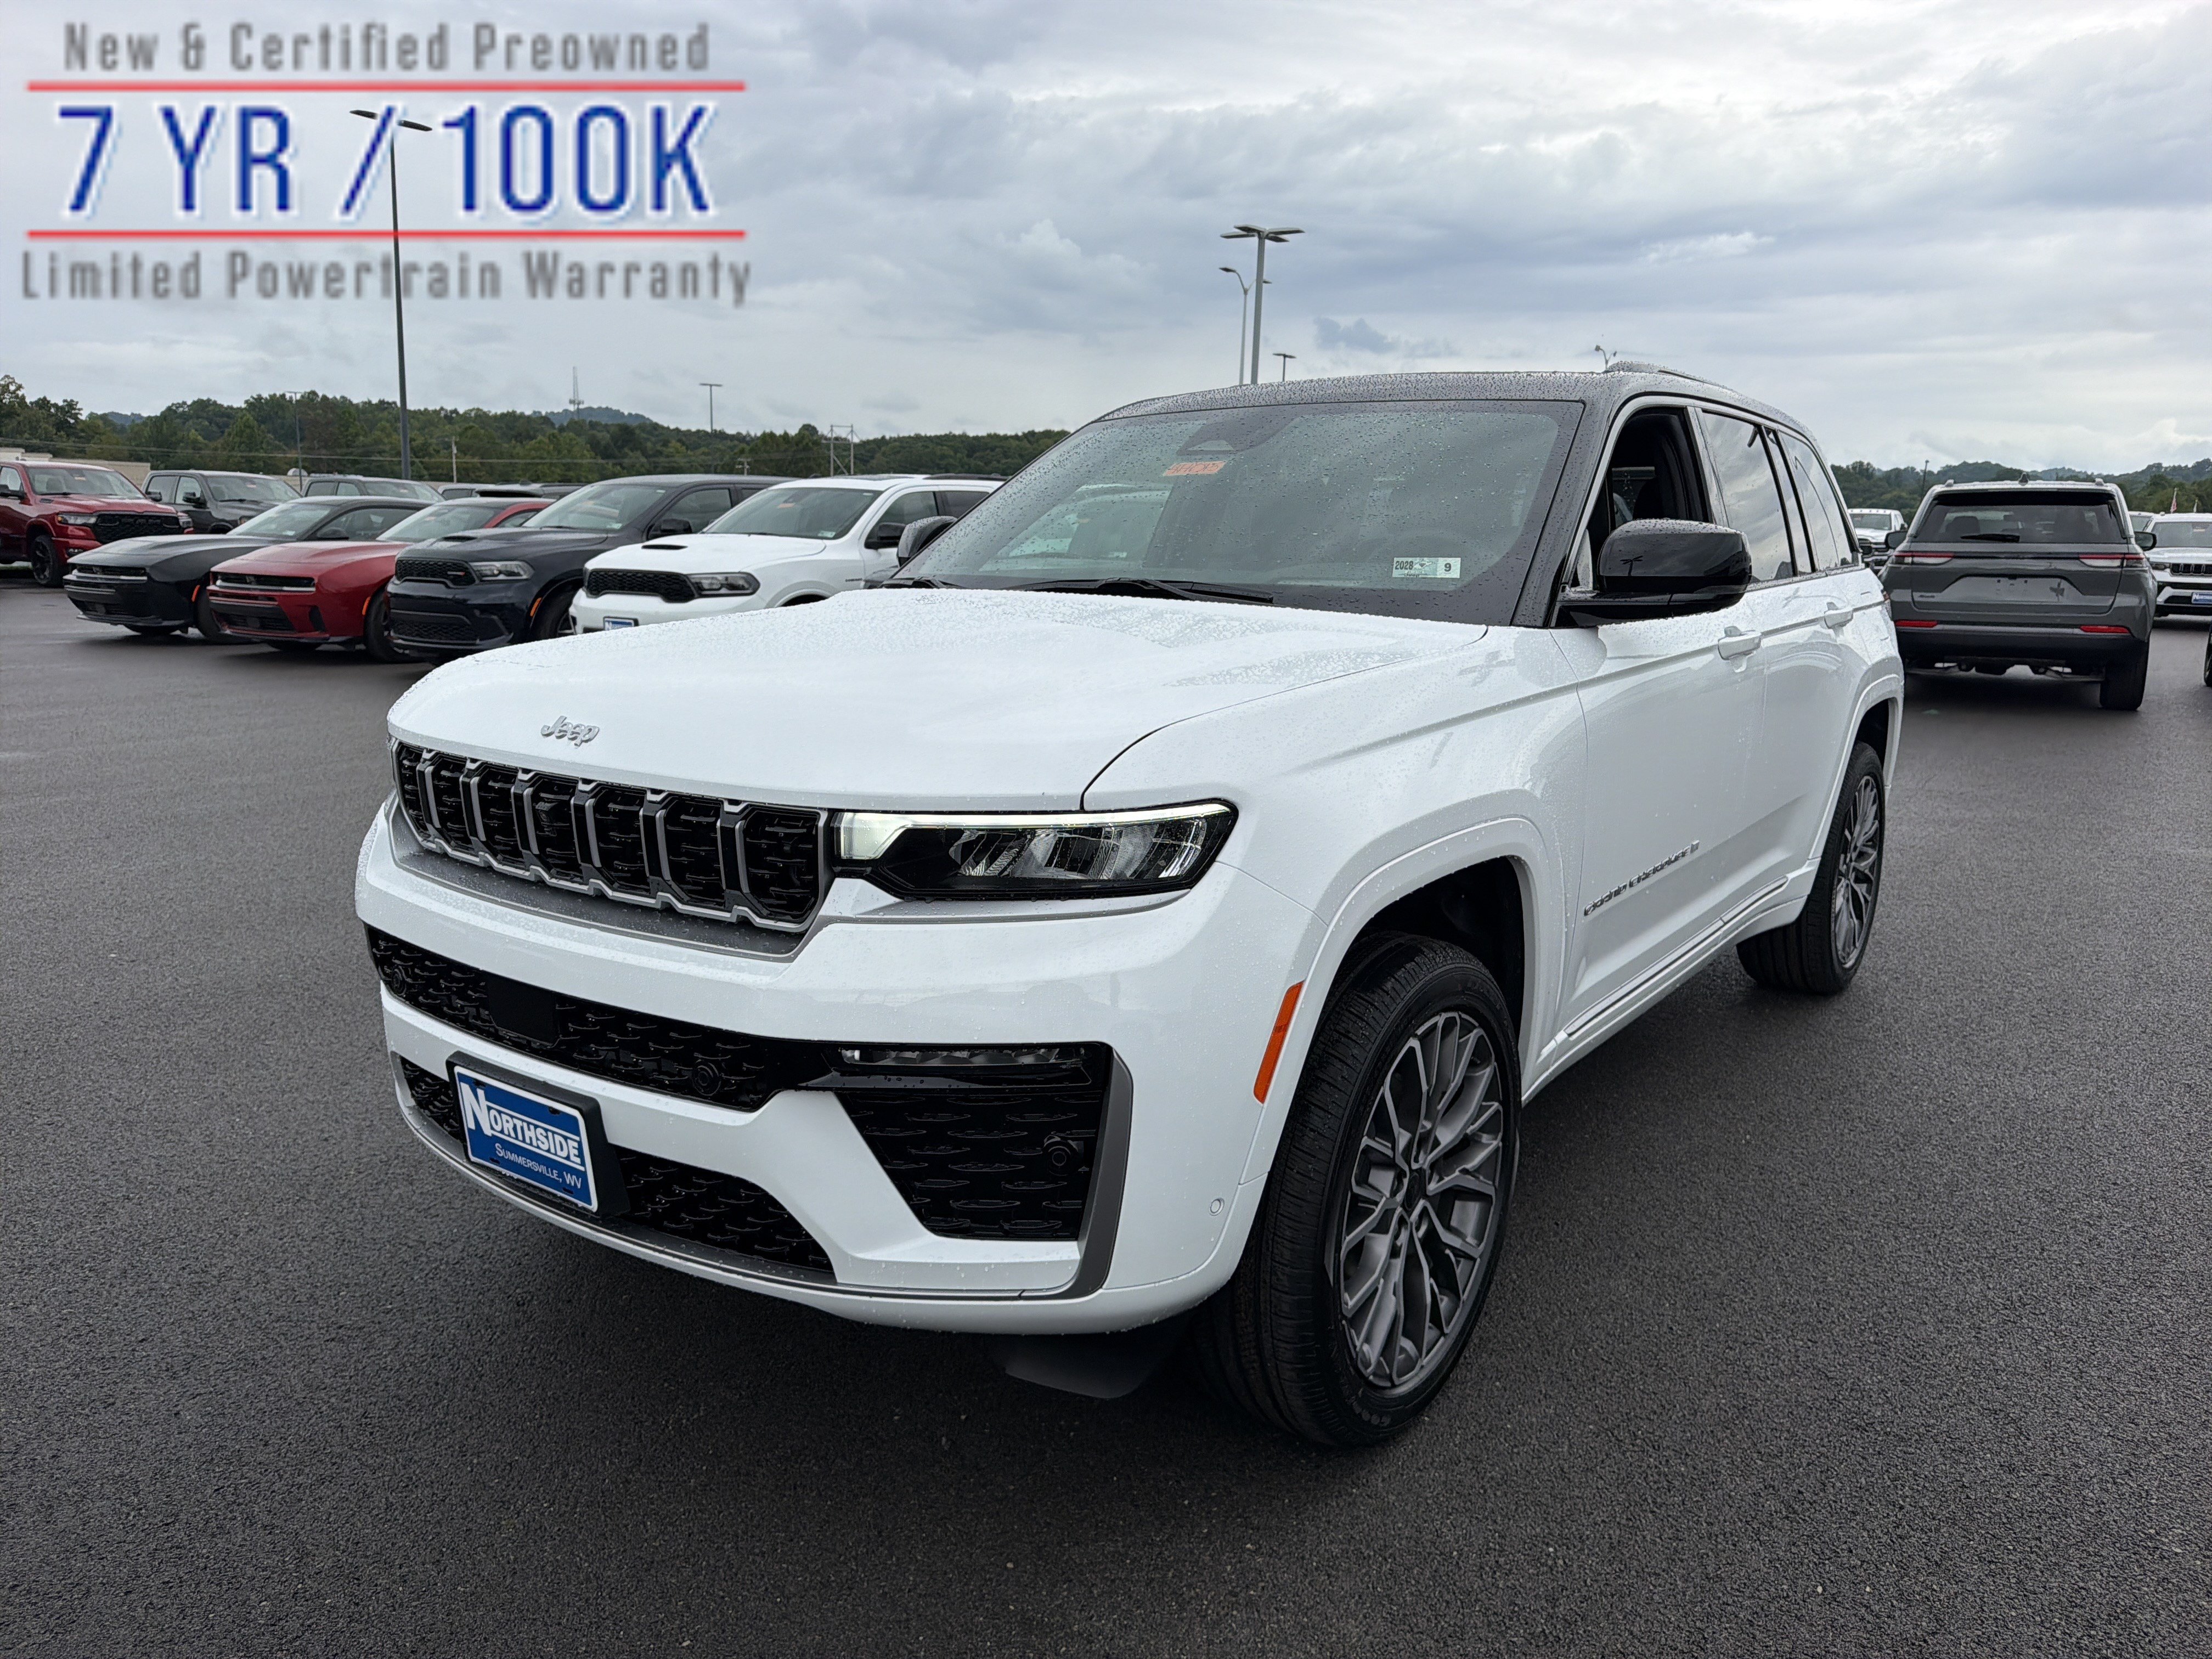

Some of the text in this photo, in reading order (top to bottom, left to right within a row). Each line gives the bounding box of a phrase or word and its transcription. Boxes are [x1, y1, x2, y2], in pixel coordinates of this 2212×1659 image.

[1395, 560, 1452, 572] 2028 9
[540, 715, 600, 747] Jeep
[460, 1081, 582, 1165] NORTHSIDE
[495, 1143, 582, 1189] SUMMERSVILLE, WV
